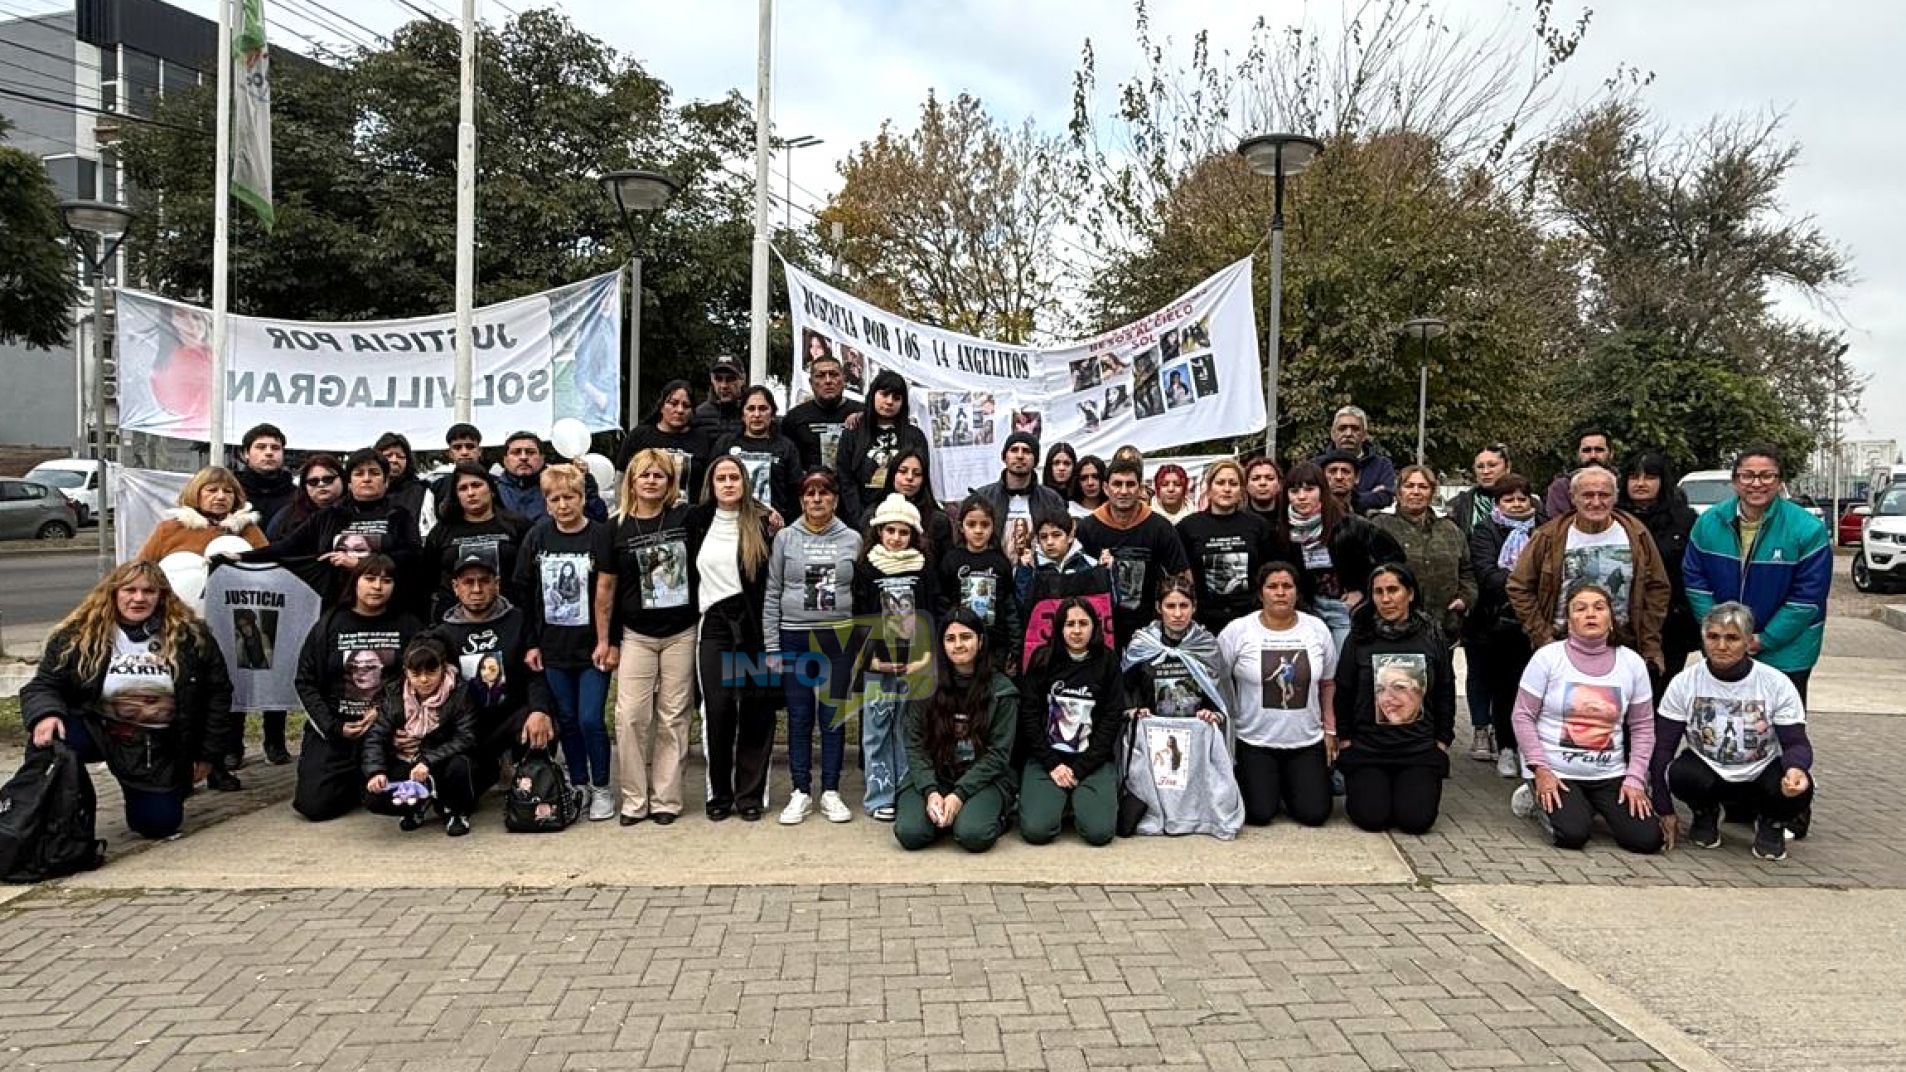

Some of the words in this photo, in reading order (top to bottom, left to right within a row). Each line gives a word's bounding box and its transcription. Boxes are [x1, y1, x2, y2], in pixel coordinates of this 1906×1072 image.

[1154, 304, 1194, 328] CIELO
[862, 315, 890, 352] POR
[933, 339, 950, 368] 14
[958, 343, 1030, 380] ANGELITOS
[1131, 334, 1158, 350] SOL
[224, 589, 286, 608] JUSTICIA
